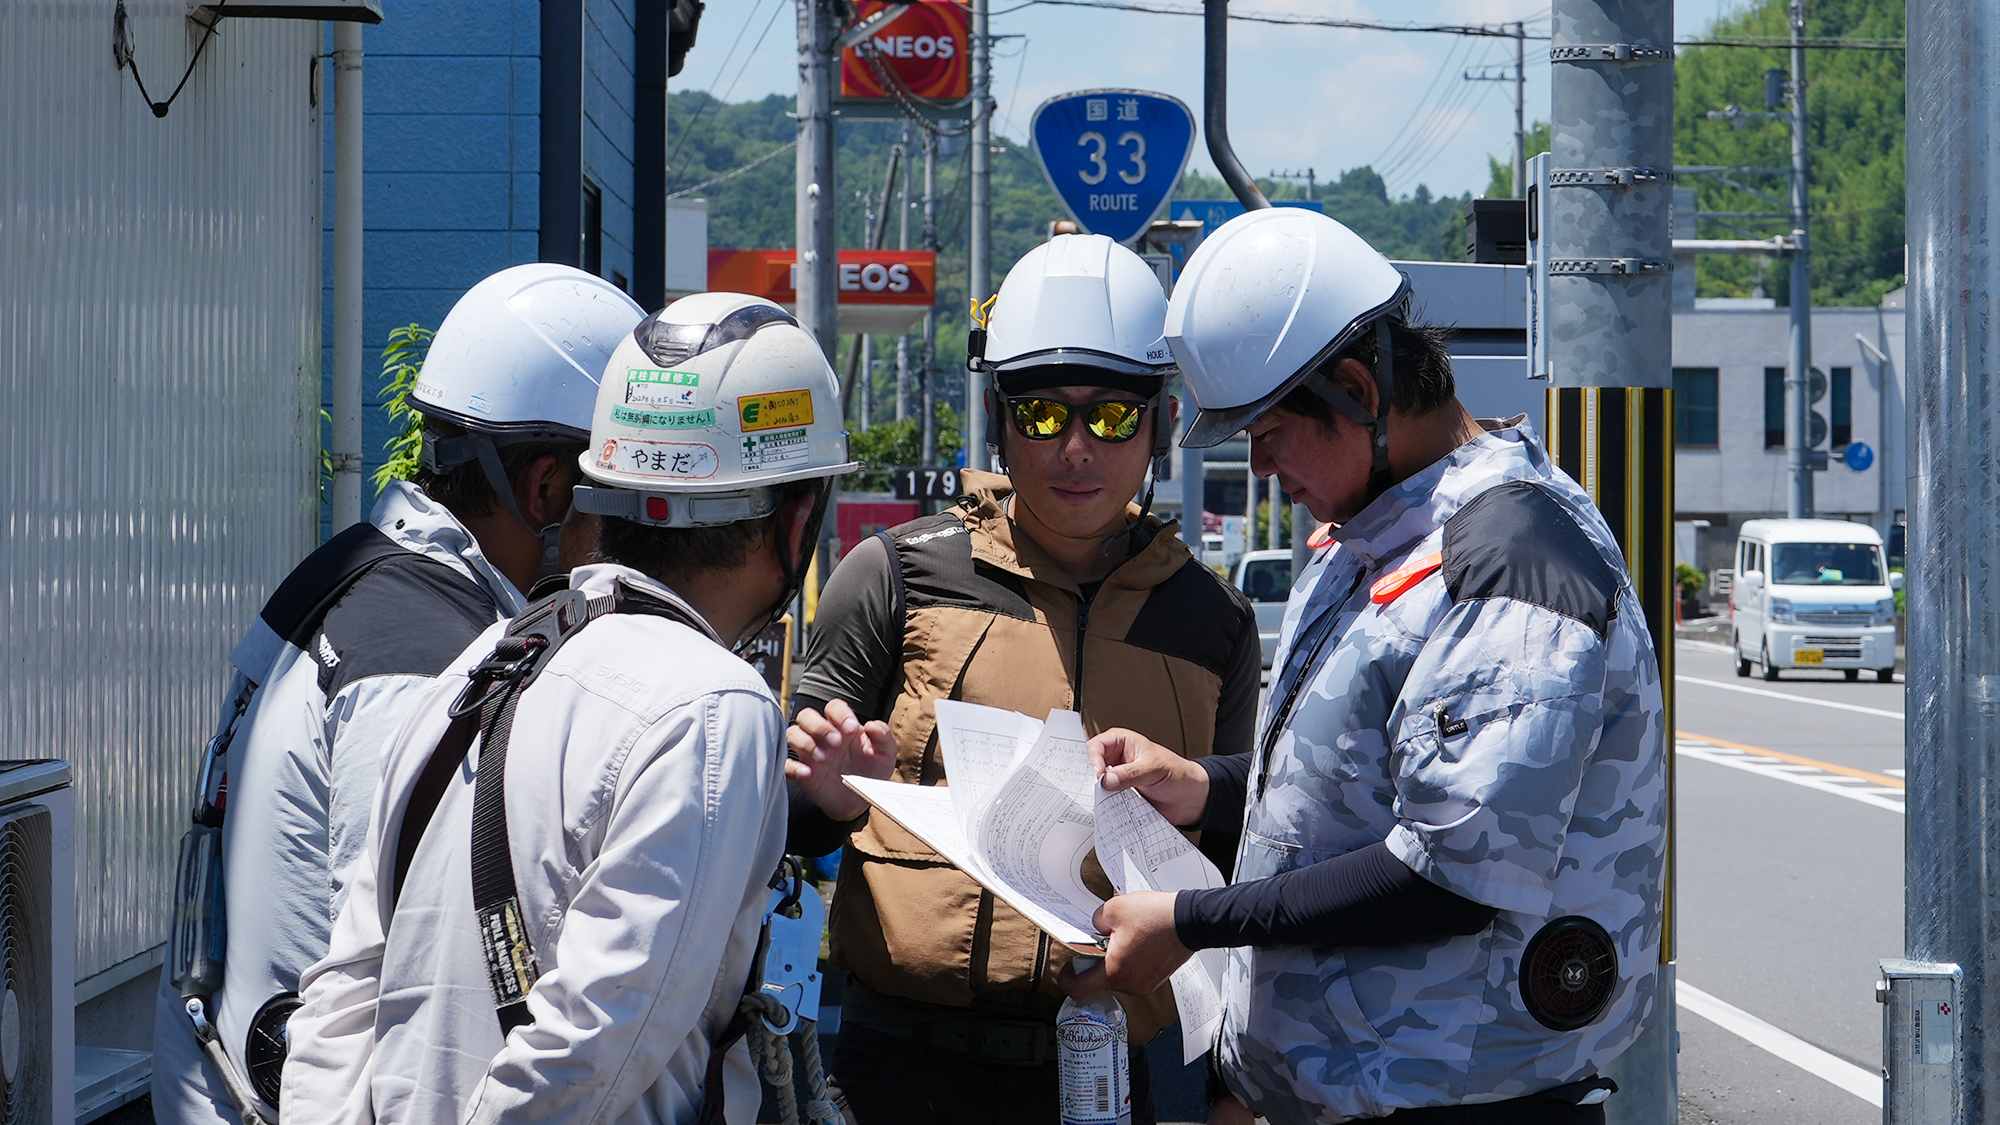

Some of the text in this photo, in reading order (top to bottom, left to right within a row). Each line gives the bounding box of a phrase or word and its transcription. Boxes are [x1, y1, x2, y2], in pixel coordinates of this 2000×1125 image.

[1086, 99, 1139, 121] 国道
[1078, 131, 1147, 186] 33
[1089, 194, 1139, 212] ROUTE
[789, 263, 911, 292] EOS
[631, 449, 691, 474] やまだ
[907, 470, 956, 496] 179
[490, 914, 504, 940] FULL
